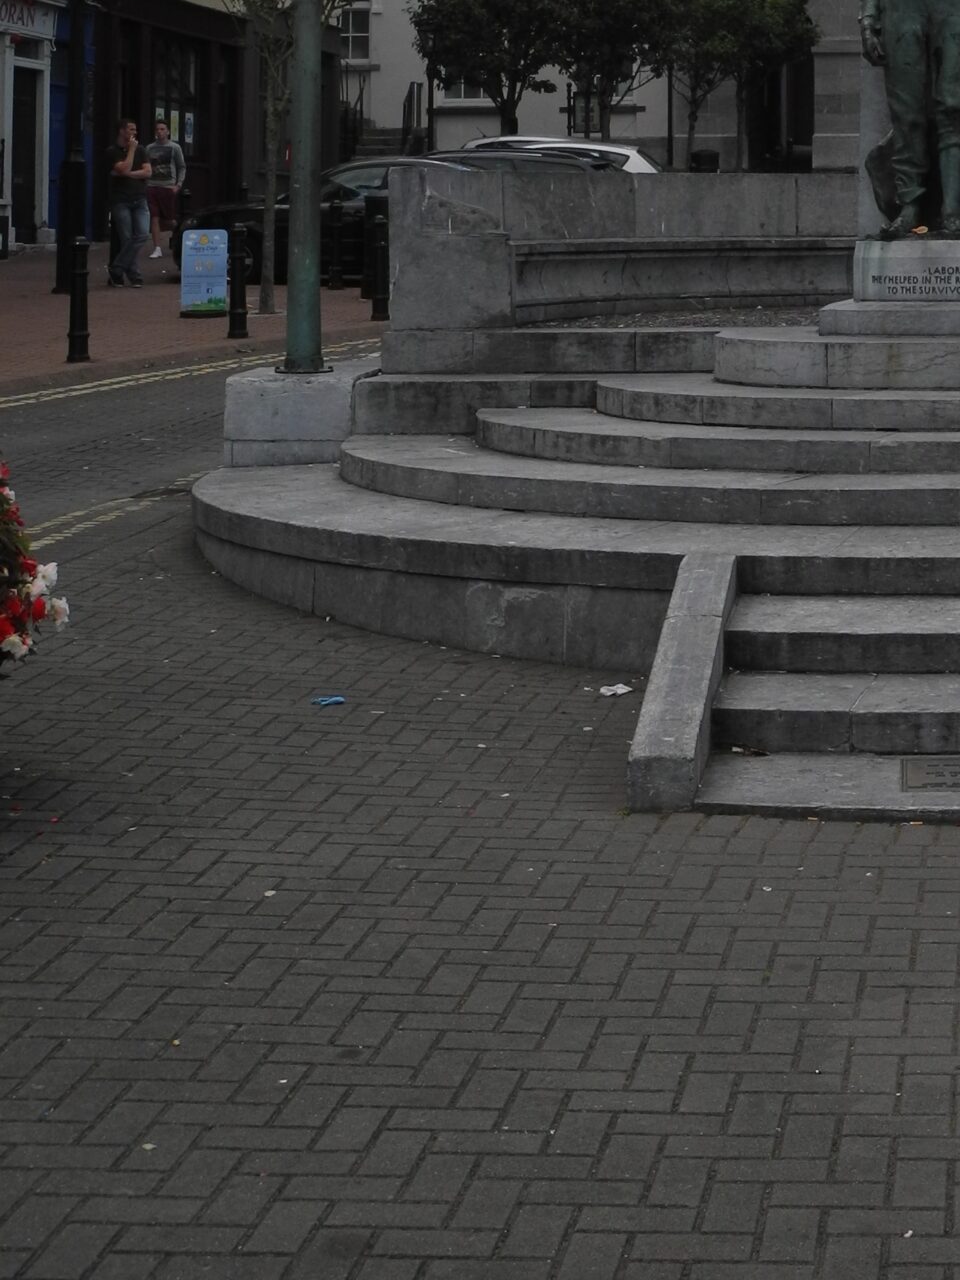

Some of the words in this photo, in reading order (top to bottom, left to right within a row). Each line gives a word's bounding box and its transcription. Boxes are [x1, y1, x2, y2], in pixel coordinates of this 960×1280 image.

[888, 275, 919, 285] HELPED
[921, 275, 932, 284] IN
[935, 275, 952, 284] THE
[887, 286, 898, 295] TO
[900, 286, 917, 295] THE
